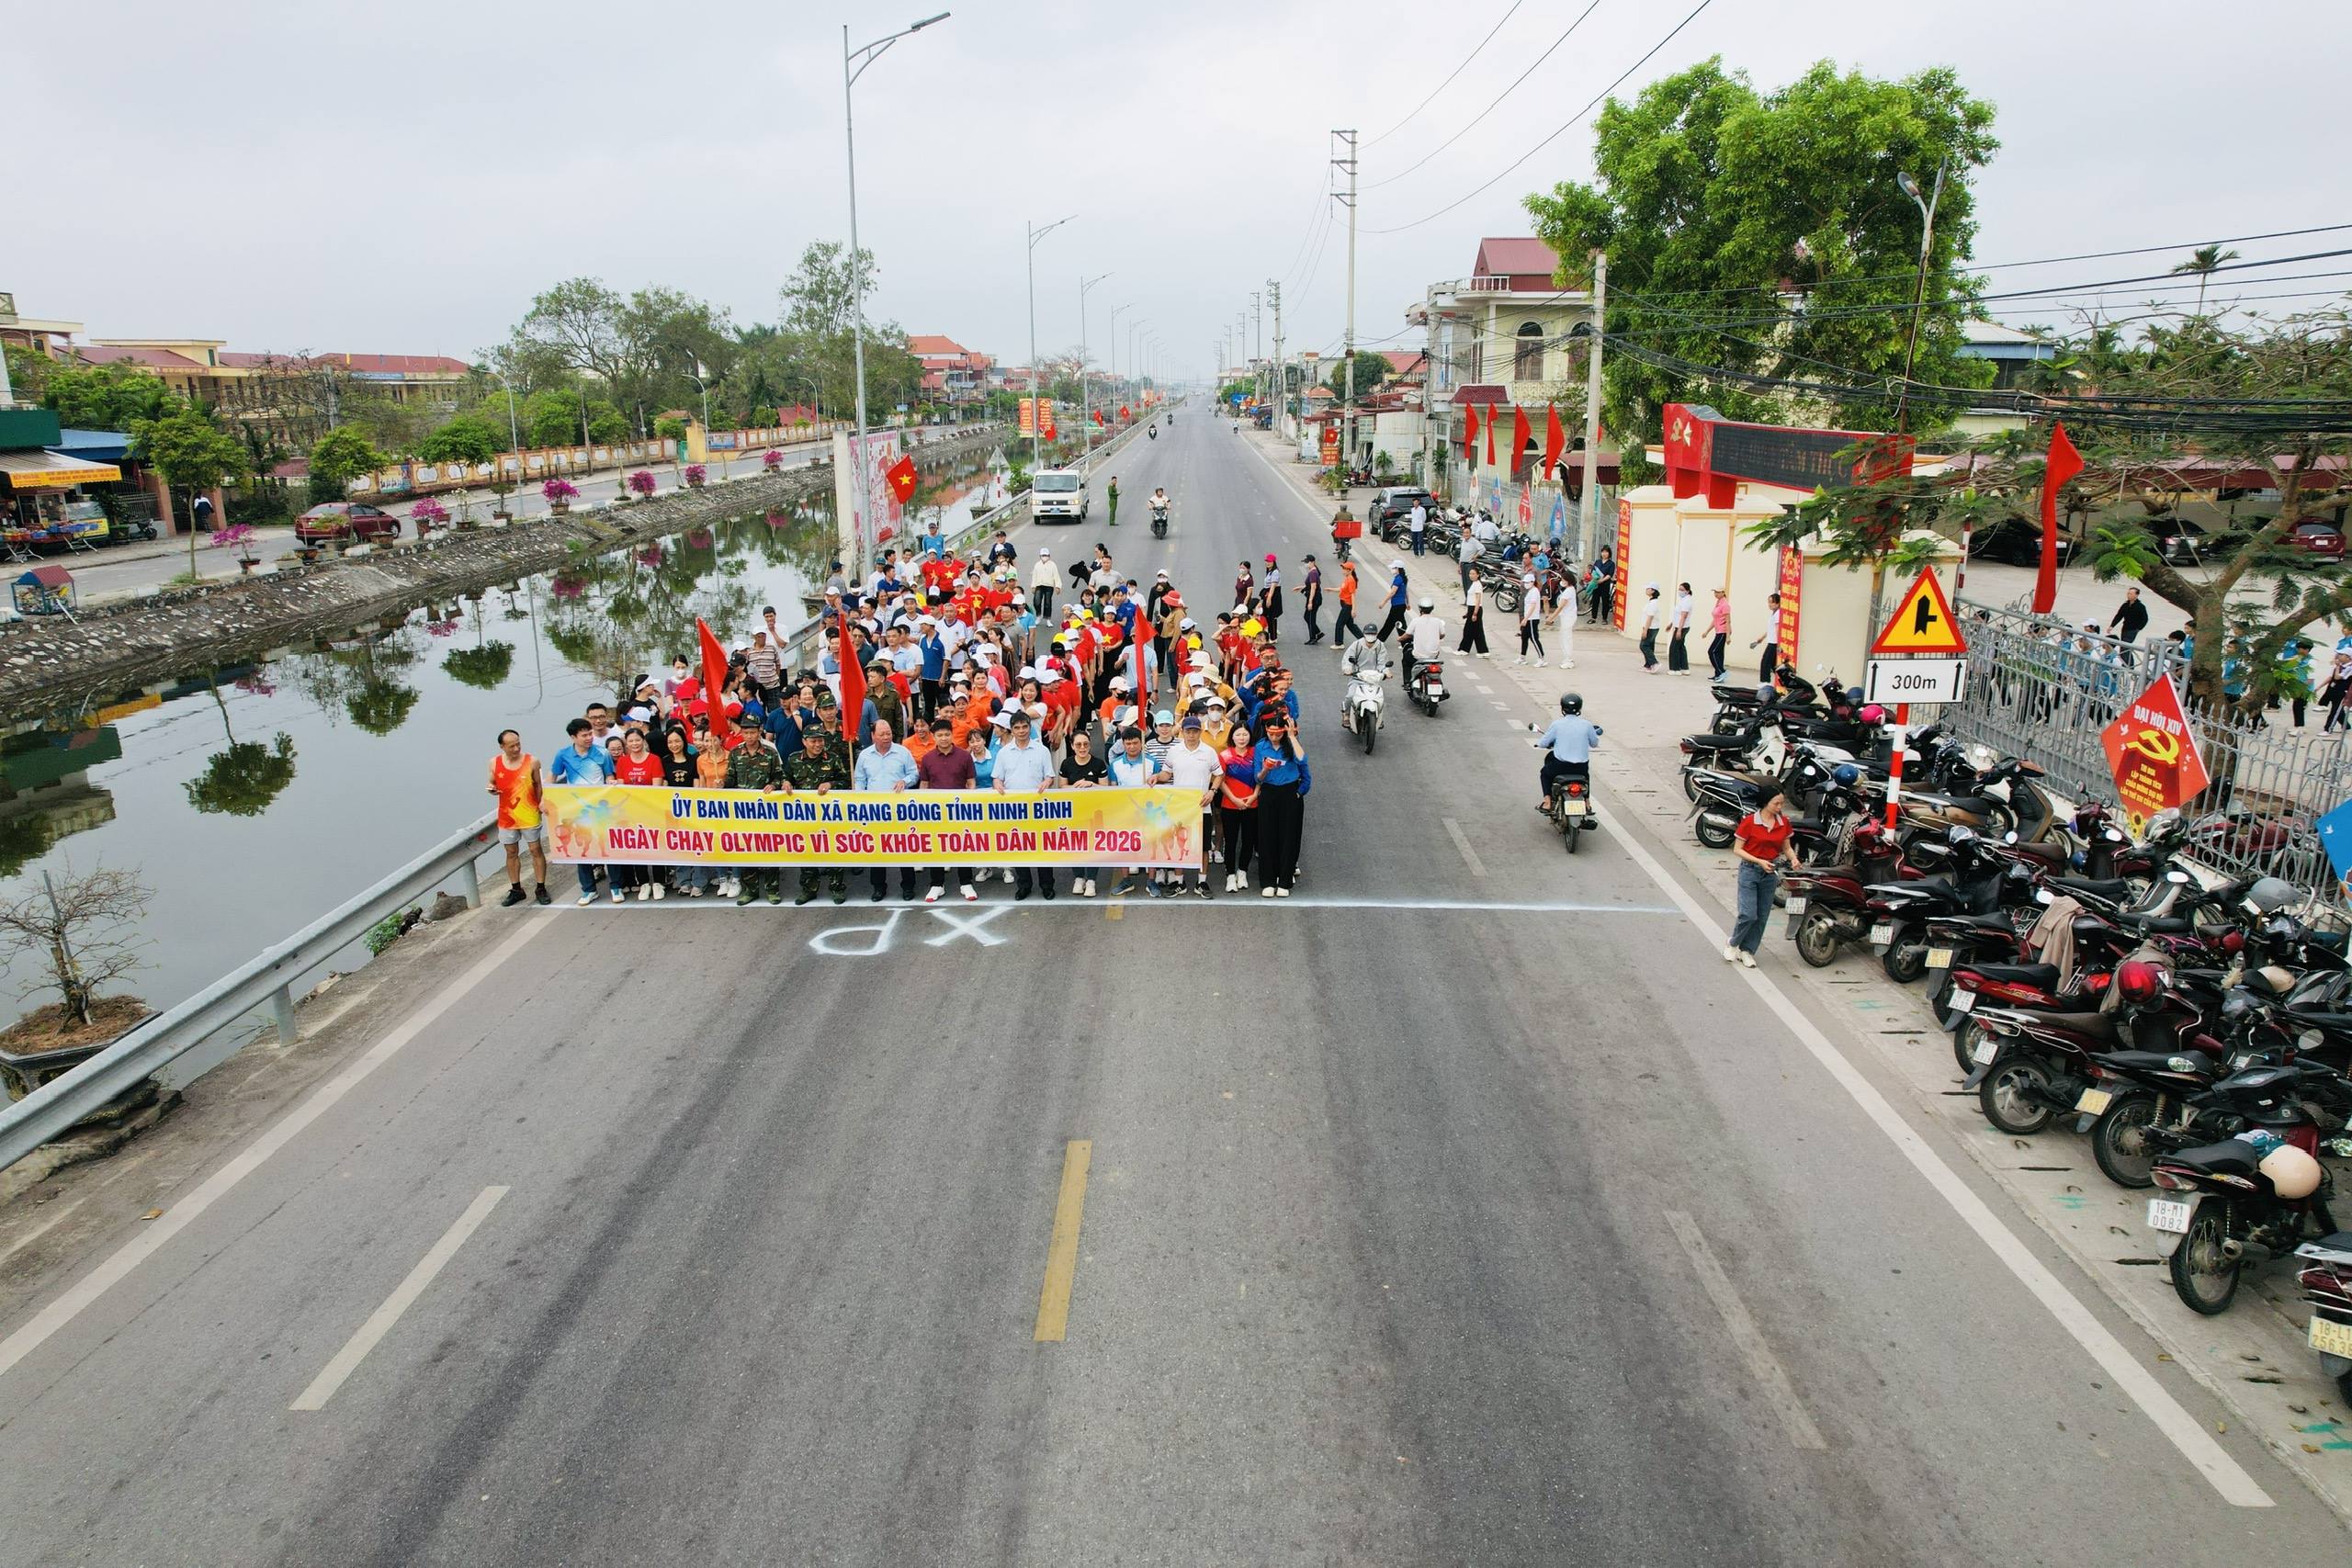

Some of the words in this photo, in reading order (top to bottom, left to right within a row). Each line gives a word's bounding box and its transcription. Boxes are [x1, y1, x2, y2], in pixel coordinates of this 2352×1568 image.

[1892, 674, 1937, 690] 300m
[2133, 705, 2150, 724] ĐẠI
[2149, 712, 2167, 731] HỘI
[2166, 719, 2182, 736] XIV
[672, 792, 692, 819] ỦY
[697, 798, 730, 820] BAN
[734, 796, 777, 821] NHÂN
[783, 799, 816, 821] DÂN
[820, 801, 842, 821] XÃ
[847, 804, 893, 827] RẠNG
[896, 800, 942, 821] ĐÔNG
[945, 796, 983, 821] TỈNH
[988, 802, 1029, 821] NINH
[1034, 799, 1072, 819] BÌNH
[608, 825, 660, 851] NGÀY
[665, 829, 714, 856] CHẠY
[720, 831, 805, 854] OLYMPIC
[809, 828, 830, 853] VÌ
[835, 827, 875, 854] SỨC
[880, 827, 932, 853] KHỎE
[937, 828, 990, 853] TOÀN
[995, 827, 1037, 852] DÂN
[1042, 826, 1089, 852] NĂM
[1093, 829, 1142, 853] 2026
[2155, 1201, 2184, 1217] 18-M1
[2318, 1321, 2352, 1341] 18-L1
